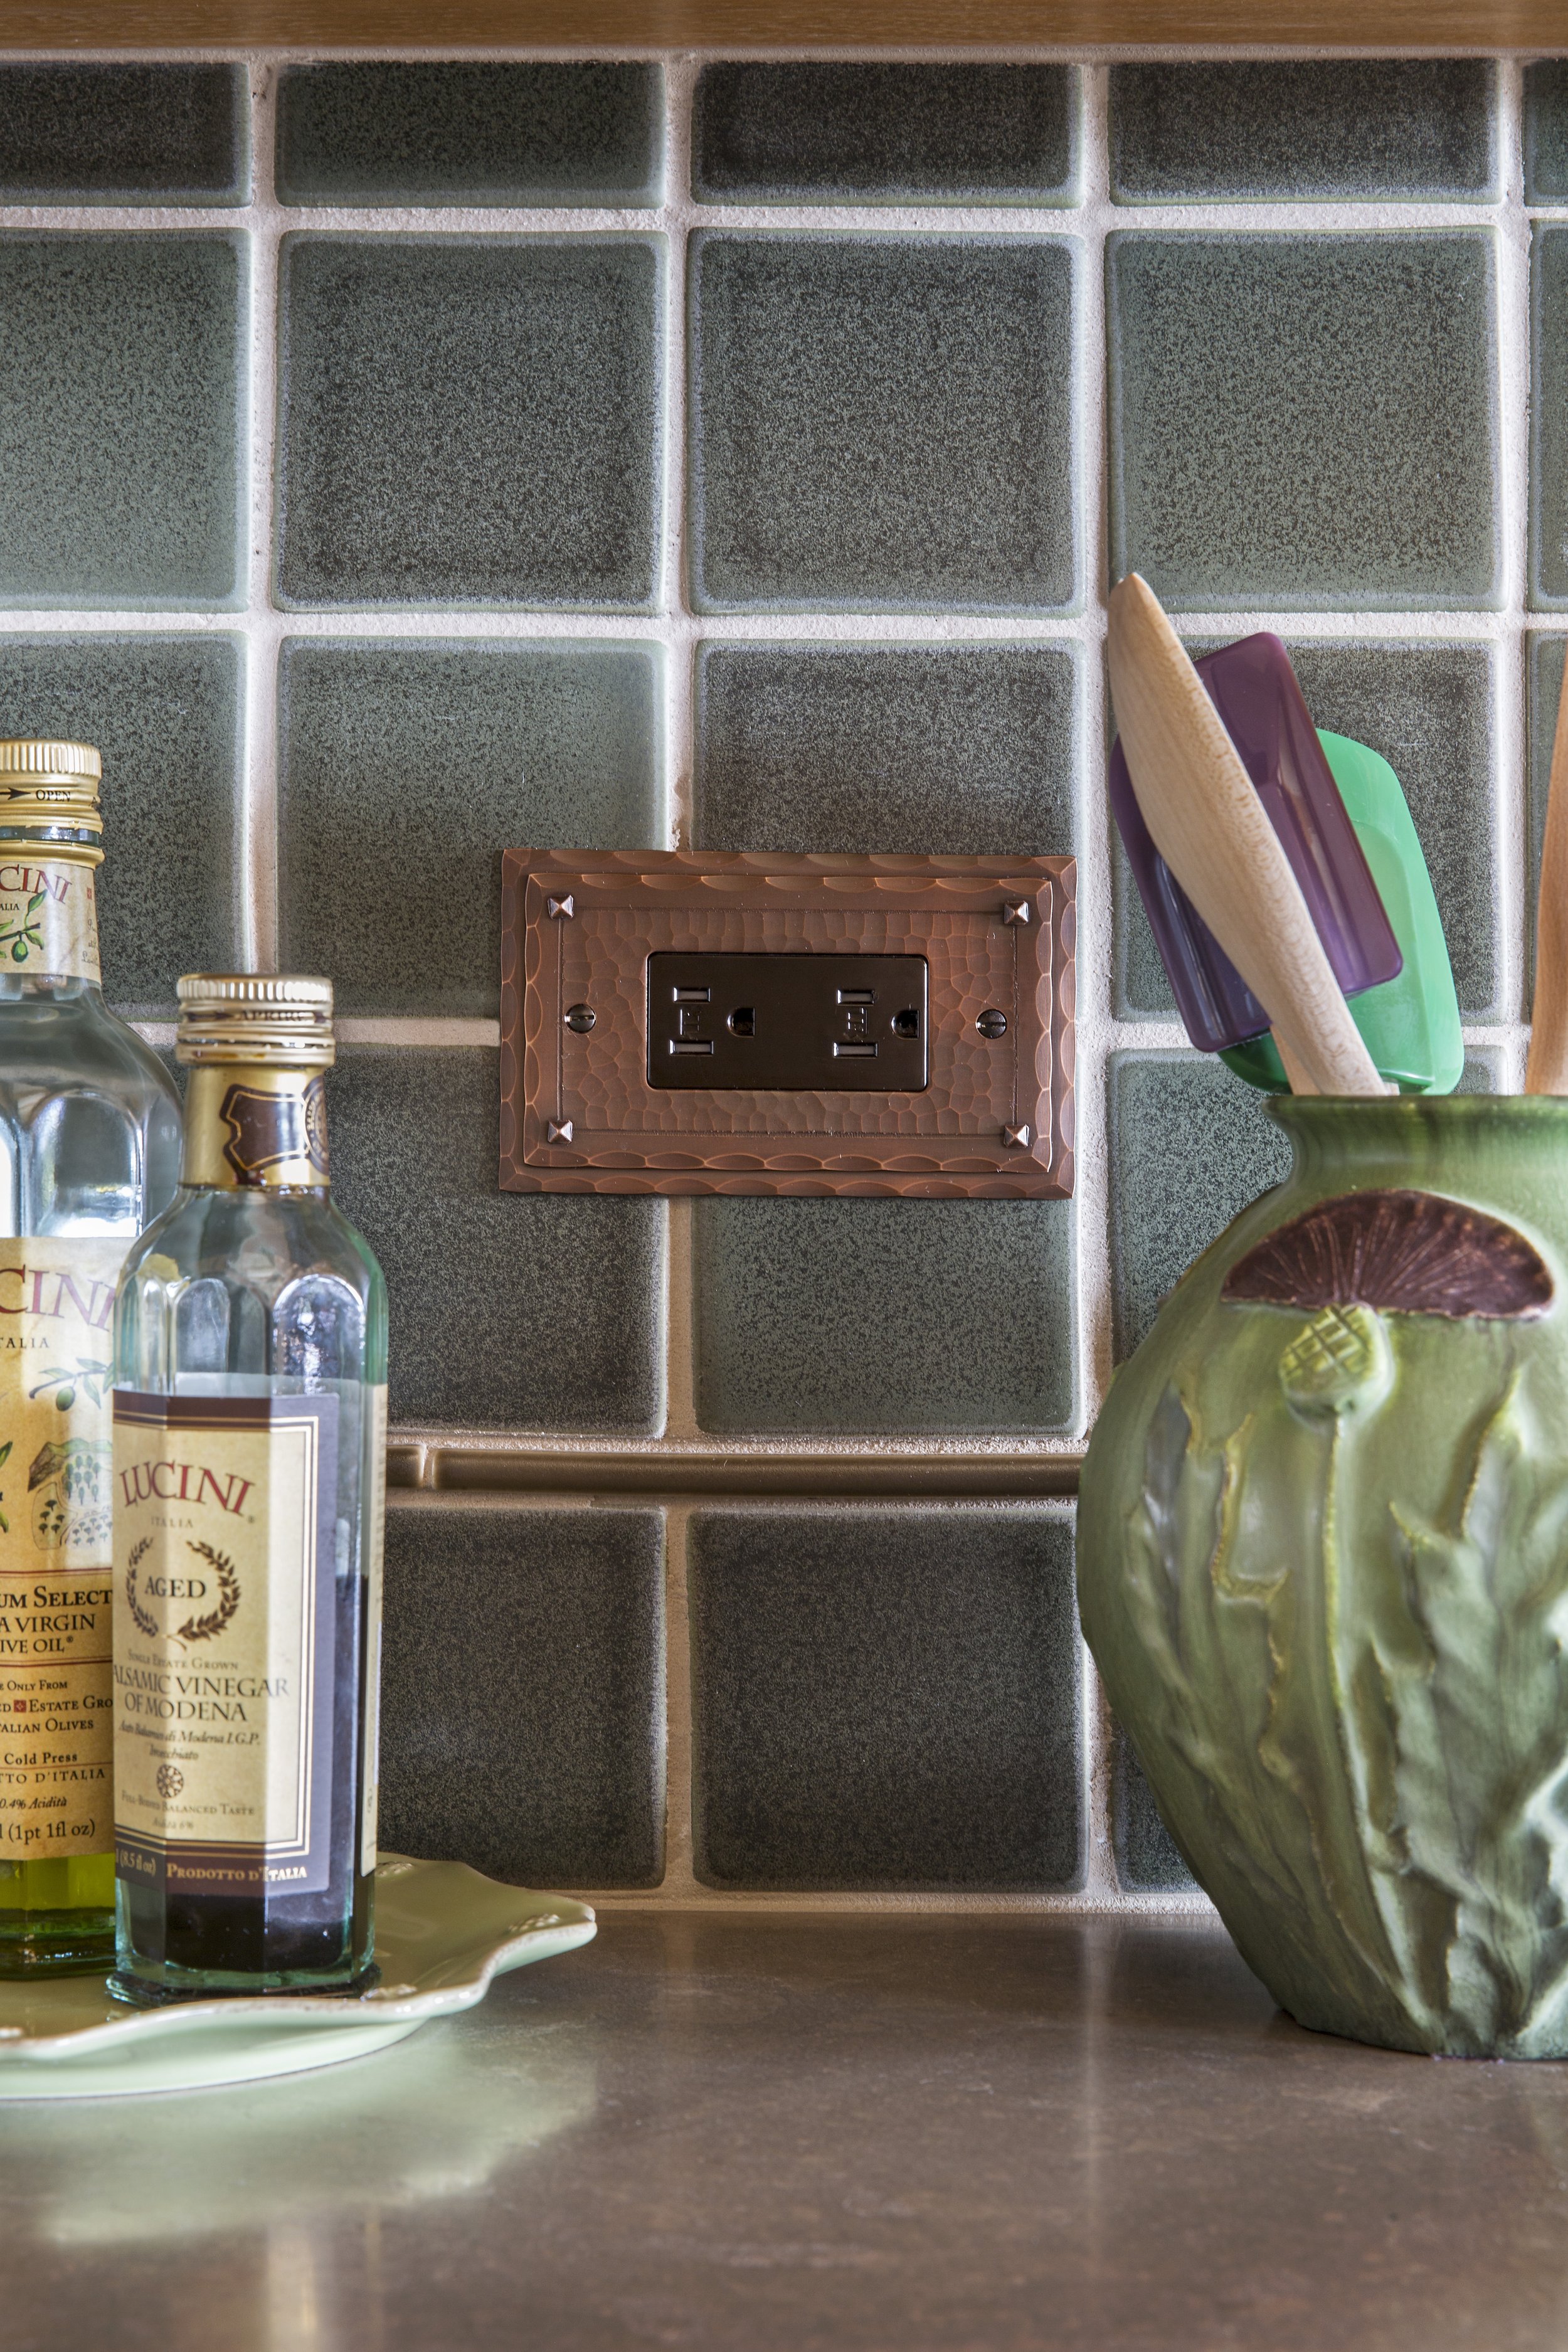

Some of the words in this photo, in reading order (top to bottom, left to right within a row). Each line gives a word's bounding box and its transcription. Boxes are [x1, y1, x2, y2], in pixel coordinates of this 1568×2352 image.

[36, 790, 71, 802] OPEN
[120, 1461, 255, 1517] LUCINI
[151, 1517, 193, 1527] ITALIA
[144, 1577, 206, 1598] AGED
[34, 1586, 112, 1608] SELECT
[16, 1614, 95, 1633] VIRGIN
[152, 1653, 187, 1668] ESTATE
[191, 1658, 238, 1671] GROWN
[8, 1680, 35, 1691] ONLY
[39, 1679, 68, 1690] FROM
[176, 1677, 289, 1698] VINEGAR
[29, 1699, 78, 1713] ESTATE
[125, 1692, 144, 1712] OF
[146, 1698, 248, 1722] MODENA
[0, 1724, 40, 1733] ALIAN
[46, 1718, 93, 1732] OLIVES
[179, 1731, 225, 1744] Modena
[4, 1753, 36, 1765] Cold
[43, 1752, 77, 1763] Press
[36, 1769, 105, 1783] D'ITALIA
[28, 1796, 67, 1809] Acidità
[161, 1801, 218, 1815] BALANCED
[220, 1803, 255, 1816] TASTE
[9, 1823, 41, 1845] (1pt
[46, 1821, 66, 1838] 1fl
[72, 1818, 95, 1838] oz)
[166, 1863, 245, 1881] PRODOTTO
